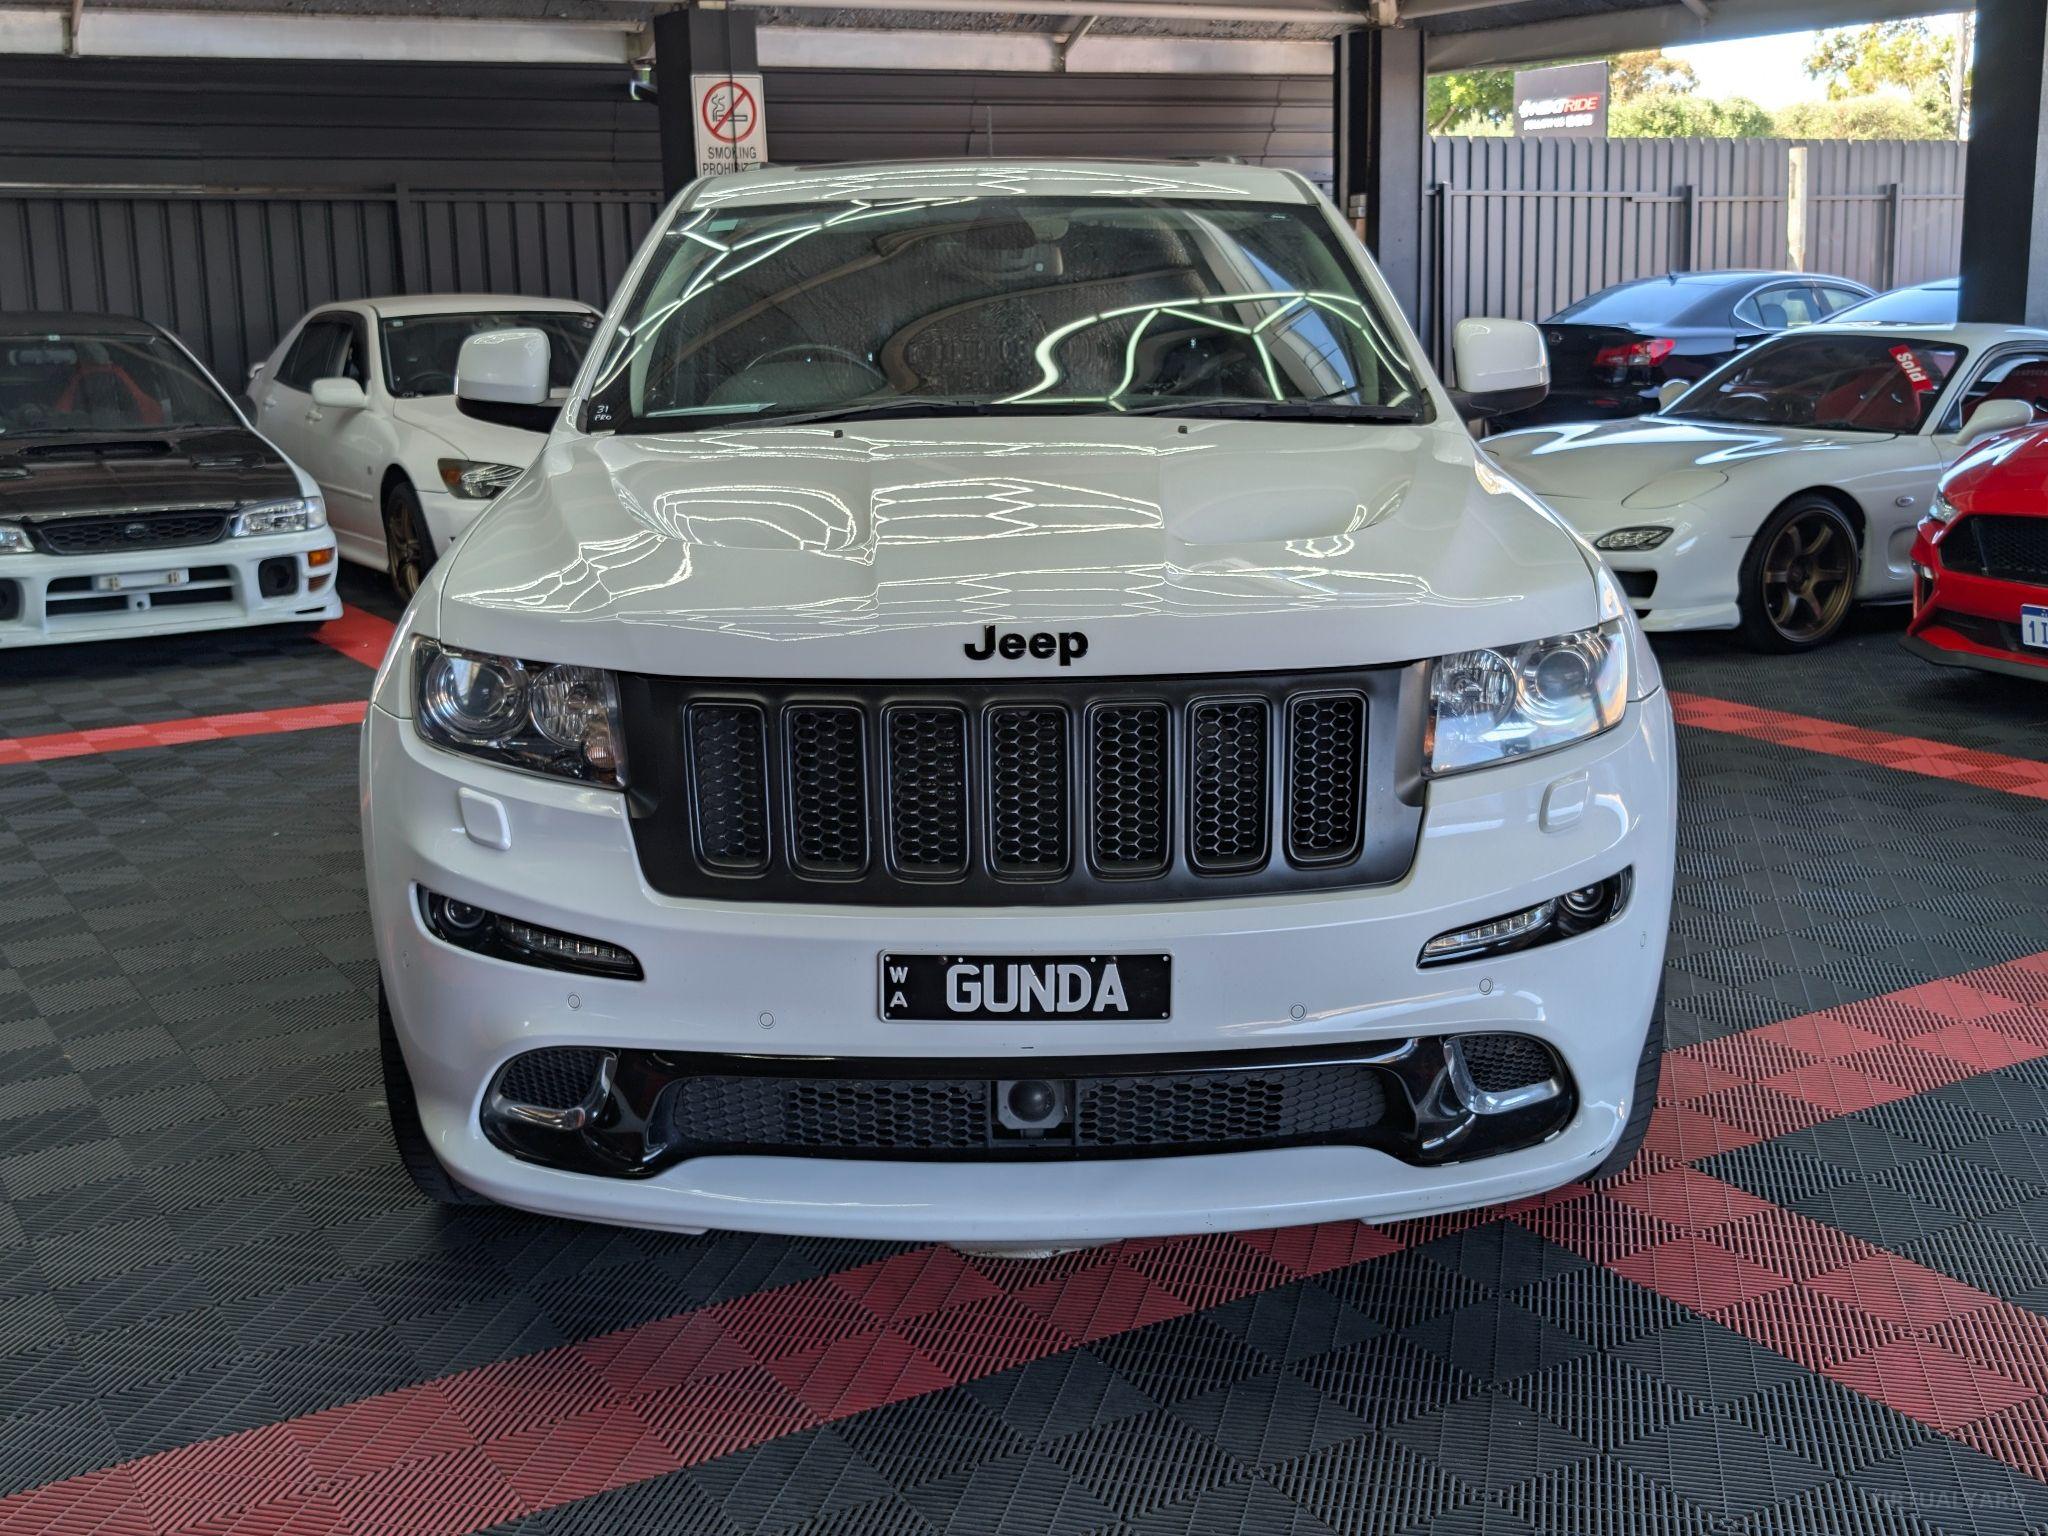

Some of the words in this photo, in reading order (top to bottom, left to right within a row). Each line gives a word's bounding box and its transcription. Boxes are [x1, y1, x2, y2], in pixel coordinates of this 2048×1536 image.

[708, 146, 757, 160] SMOKING
[1896, 352, 1927, 382] Sold
[964, 624, 1088, 667] Jeep
[946, 963, 1129, 1013] GUNDA
